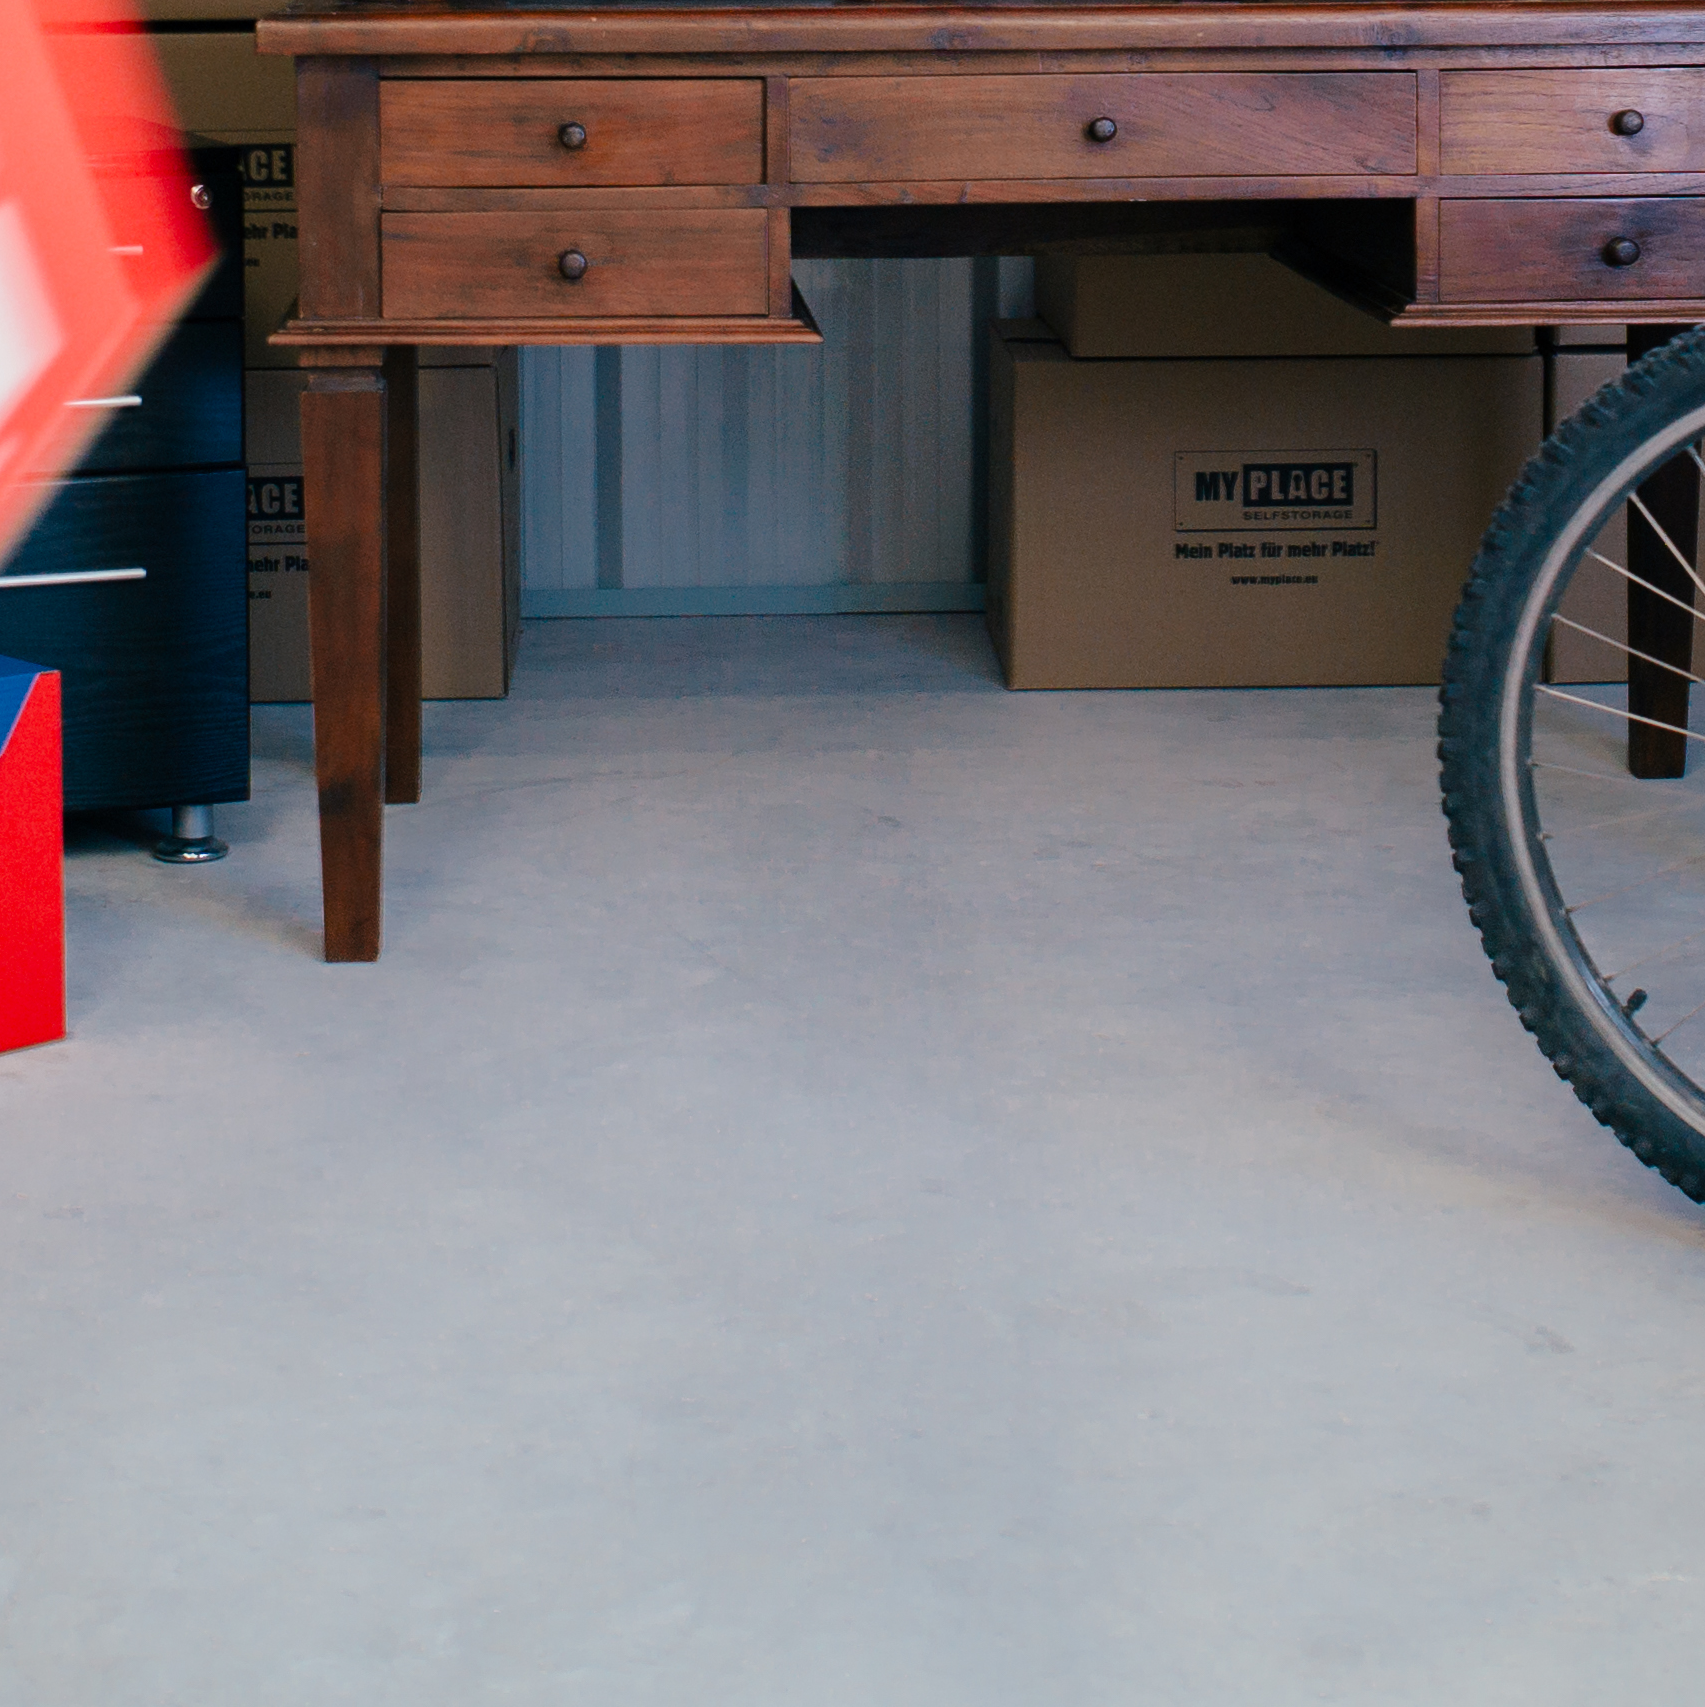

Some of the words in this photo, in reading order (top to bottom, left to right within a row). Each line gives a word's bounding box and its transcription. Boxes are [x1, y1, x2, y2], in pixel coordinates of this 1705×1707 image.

[1195, 471, 1239, 501] MY
[1250, 470, 1347, 500] PLACE
[1243, 510, 1353, 520] SELFSTORAGE
[1175, 543, 1212, 559] Mein
[1218, 543, 1255, 558] Platz
[1261, 542, 1283, 557] für
[1288, 542, 1326, 557] mehr
[285, 555, 308, 573] Pla
